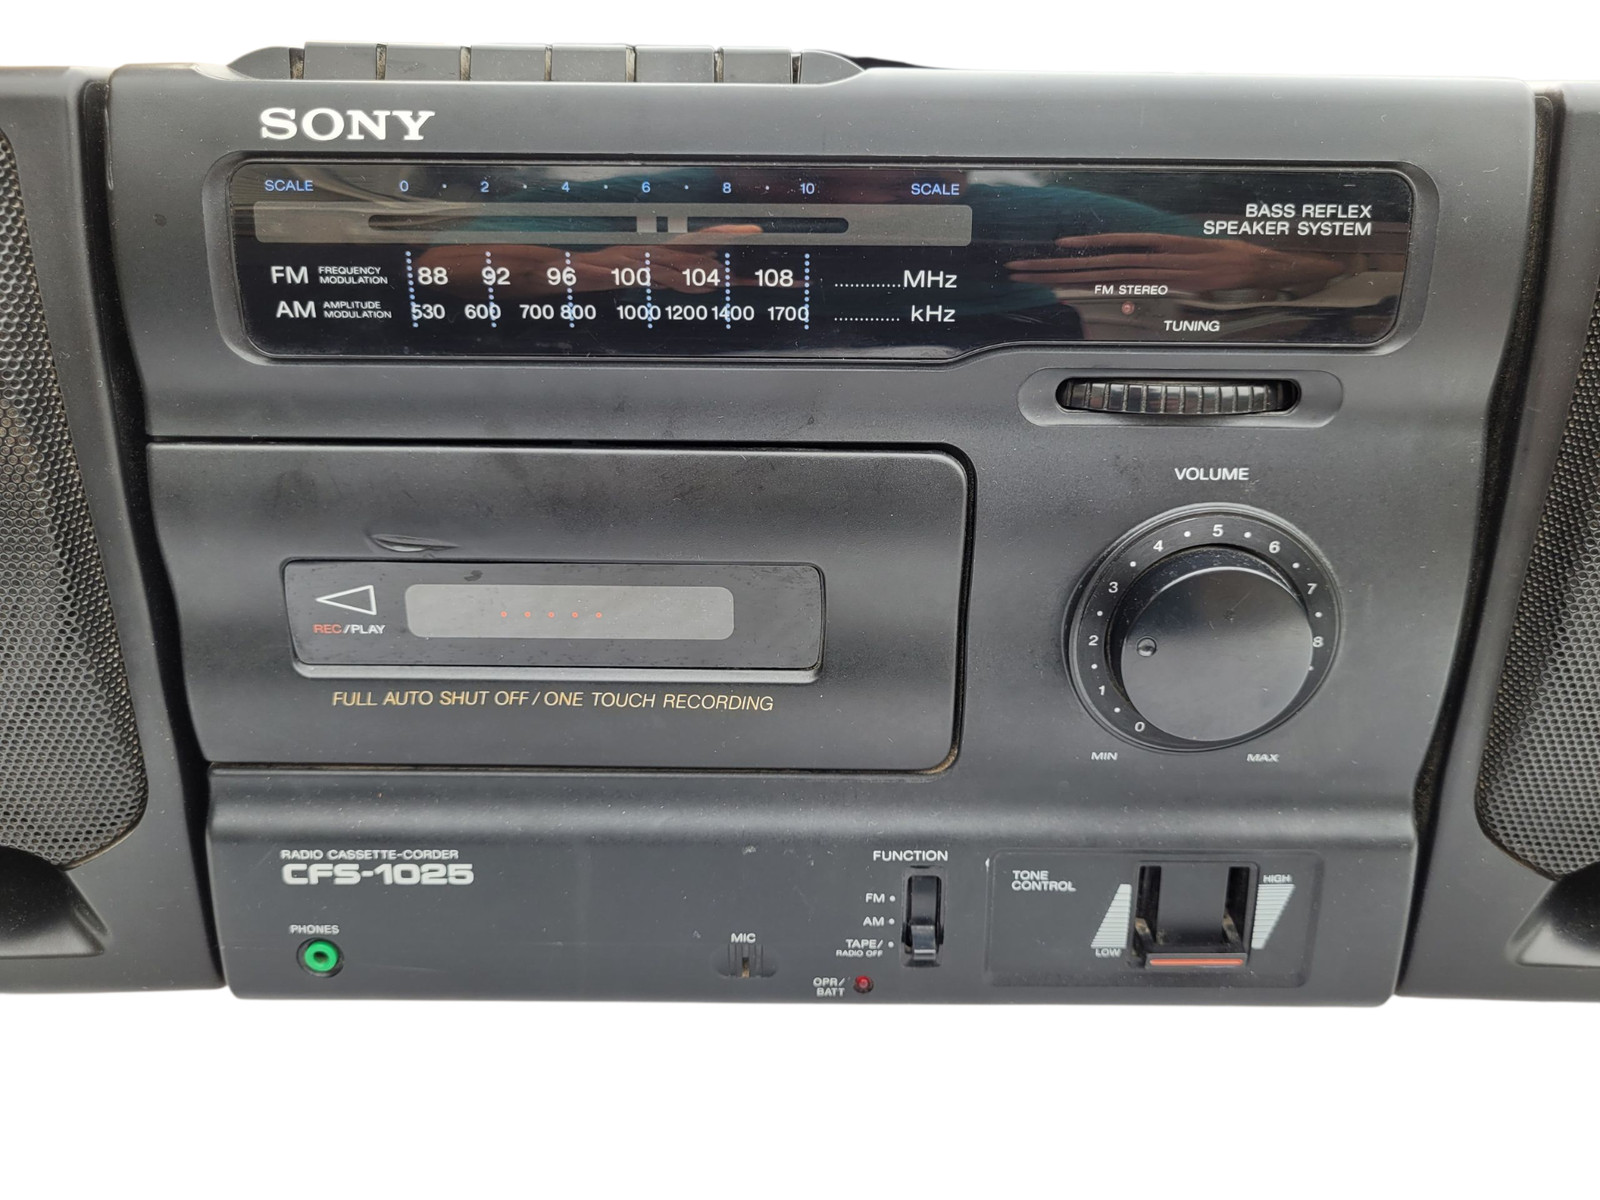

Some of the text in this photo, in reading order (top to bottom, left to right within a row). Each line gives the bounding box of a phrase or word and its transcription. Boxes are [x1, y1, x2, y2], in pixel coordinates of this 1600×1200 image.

[260, 108, 435, 141] SONY
[264, 180, 313, 191] SCALE
[399, 180, 815, 195] 0 2 4 6 8 10
[911, 183, 960, 196] SCALE
[1246, 204, 1372, 218] BASS REFLEX
[1203, 221, 1372, 236] SPEAKER SYSTEM
[271, 266, 308, 284] FM
[318, 266, 381, 275] FREQUENCY
[319, 276, 388, 284] MODULATION
[417, 267, 957, 288] 88 92 96 100 104 108 MHz
[1095, 286, 1168, 295] FM STEREO
[276, 301, 316, 318] AM
[323, 301, 381, 309] AMPLITUDE
[324, 310, 391, 318] MODULATION
[411, 304, 955, 322] 530 600 700 800 1000 1200 1400 1700 kHz
[1164, 321, 1220, 332] TUNING
[1175, 467, 1249, 480] VOLUME
[1212, 524, 1223, 537] 5
[1153, 540, 1163, 552] 4
[1269, 541, 1280, 553] 6
[1108, 582, 1118, 593] 3
[1307, 583, 1317, 594] 7
[1088, 636, 1098, 646] 2
[1313, 636, 1323, 647] 8
[1099, 686, 1105, 695] 1
[333, 691, 378, 706] FULL
[384, 691, 433, 706] AUTO
[440, 691, 489, 705] SHUT
[494, 691, 530, 706] OFF
[544, 691, 583, 707] ONE
[592, 692, 655, 708] TOUCH
[662, 693, 773, 711] RECORDING
[1135, 721, 1145, 732] 0
[1091, 752, 1118, 760] MIN
[1247, 753, 1279, 762] MAX
[280, 850, 459, 860] RADIO CASSETTE-CORDER
[873, 851, 948, 861] FUNCTION
[283, 864, 474, 885] CFS-1025
[1013, 870, 1048, 880] TONE
[1011, 881, 1076, 892] CONTROL
[866, 893, 885, 903] FM
[863, 917, 884, 926] AM
[290, 925, 339, 934] PHONES
[731, 933, 756, 943] MIC
[846, 939, 883, 949] TAPE/
[1095, 949, 1121, 958] LOW
[813, 978, 845, 987] OPR/
[817, 988, 845, 996] BATT
